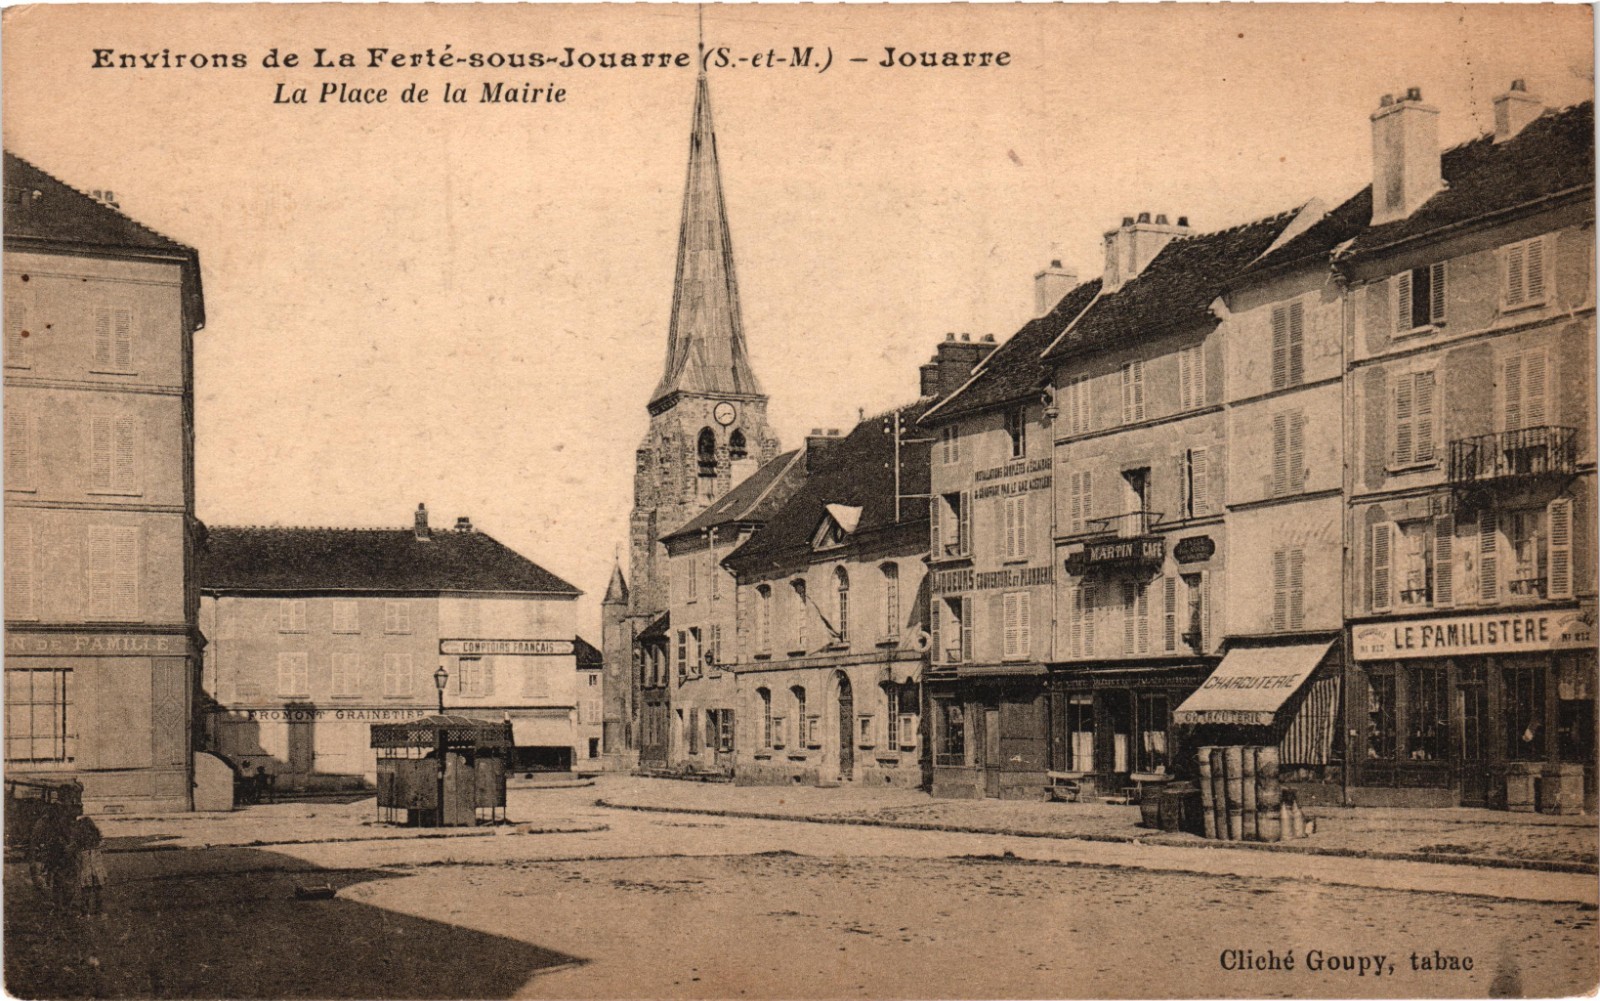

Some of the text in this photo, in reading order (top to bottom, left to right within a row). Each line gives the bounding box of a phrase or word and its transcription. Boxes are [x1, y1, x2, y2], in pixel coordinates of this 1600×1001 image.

[1090, 543, 1133, 560] MARTIN
[1394, 626, 1415, 649] LE
[1421, 614, 1549, 648] FAMILISTÈRE
[36, 639, 62, 650] DE
[74, 636, 169, 651] FAMILLE
[463, 642, 510, 653] COMPTOIRS
[1203, 674, 1301, 689] CHARCUTERIE
[248, 709, 325, 721] FROMONT
[1185, 711, 1261, 723] CHRCUTERIE
